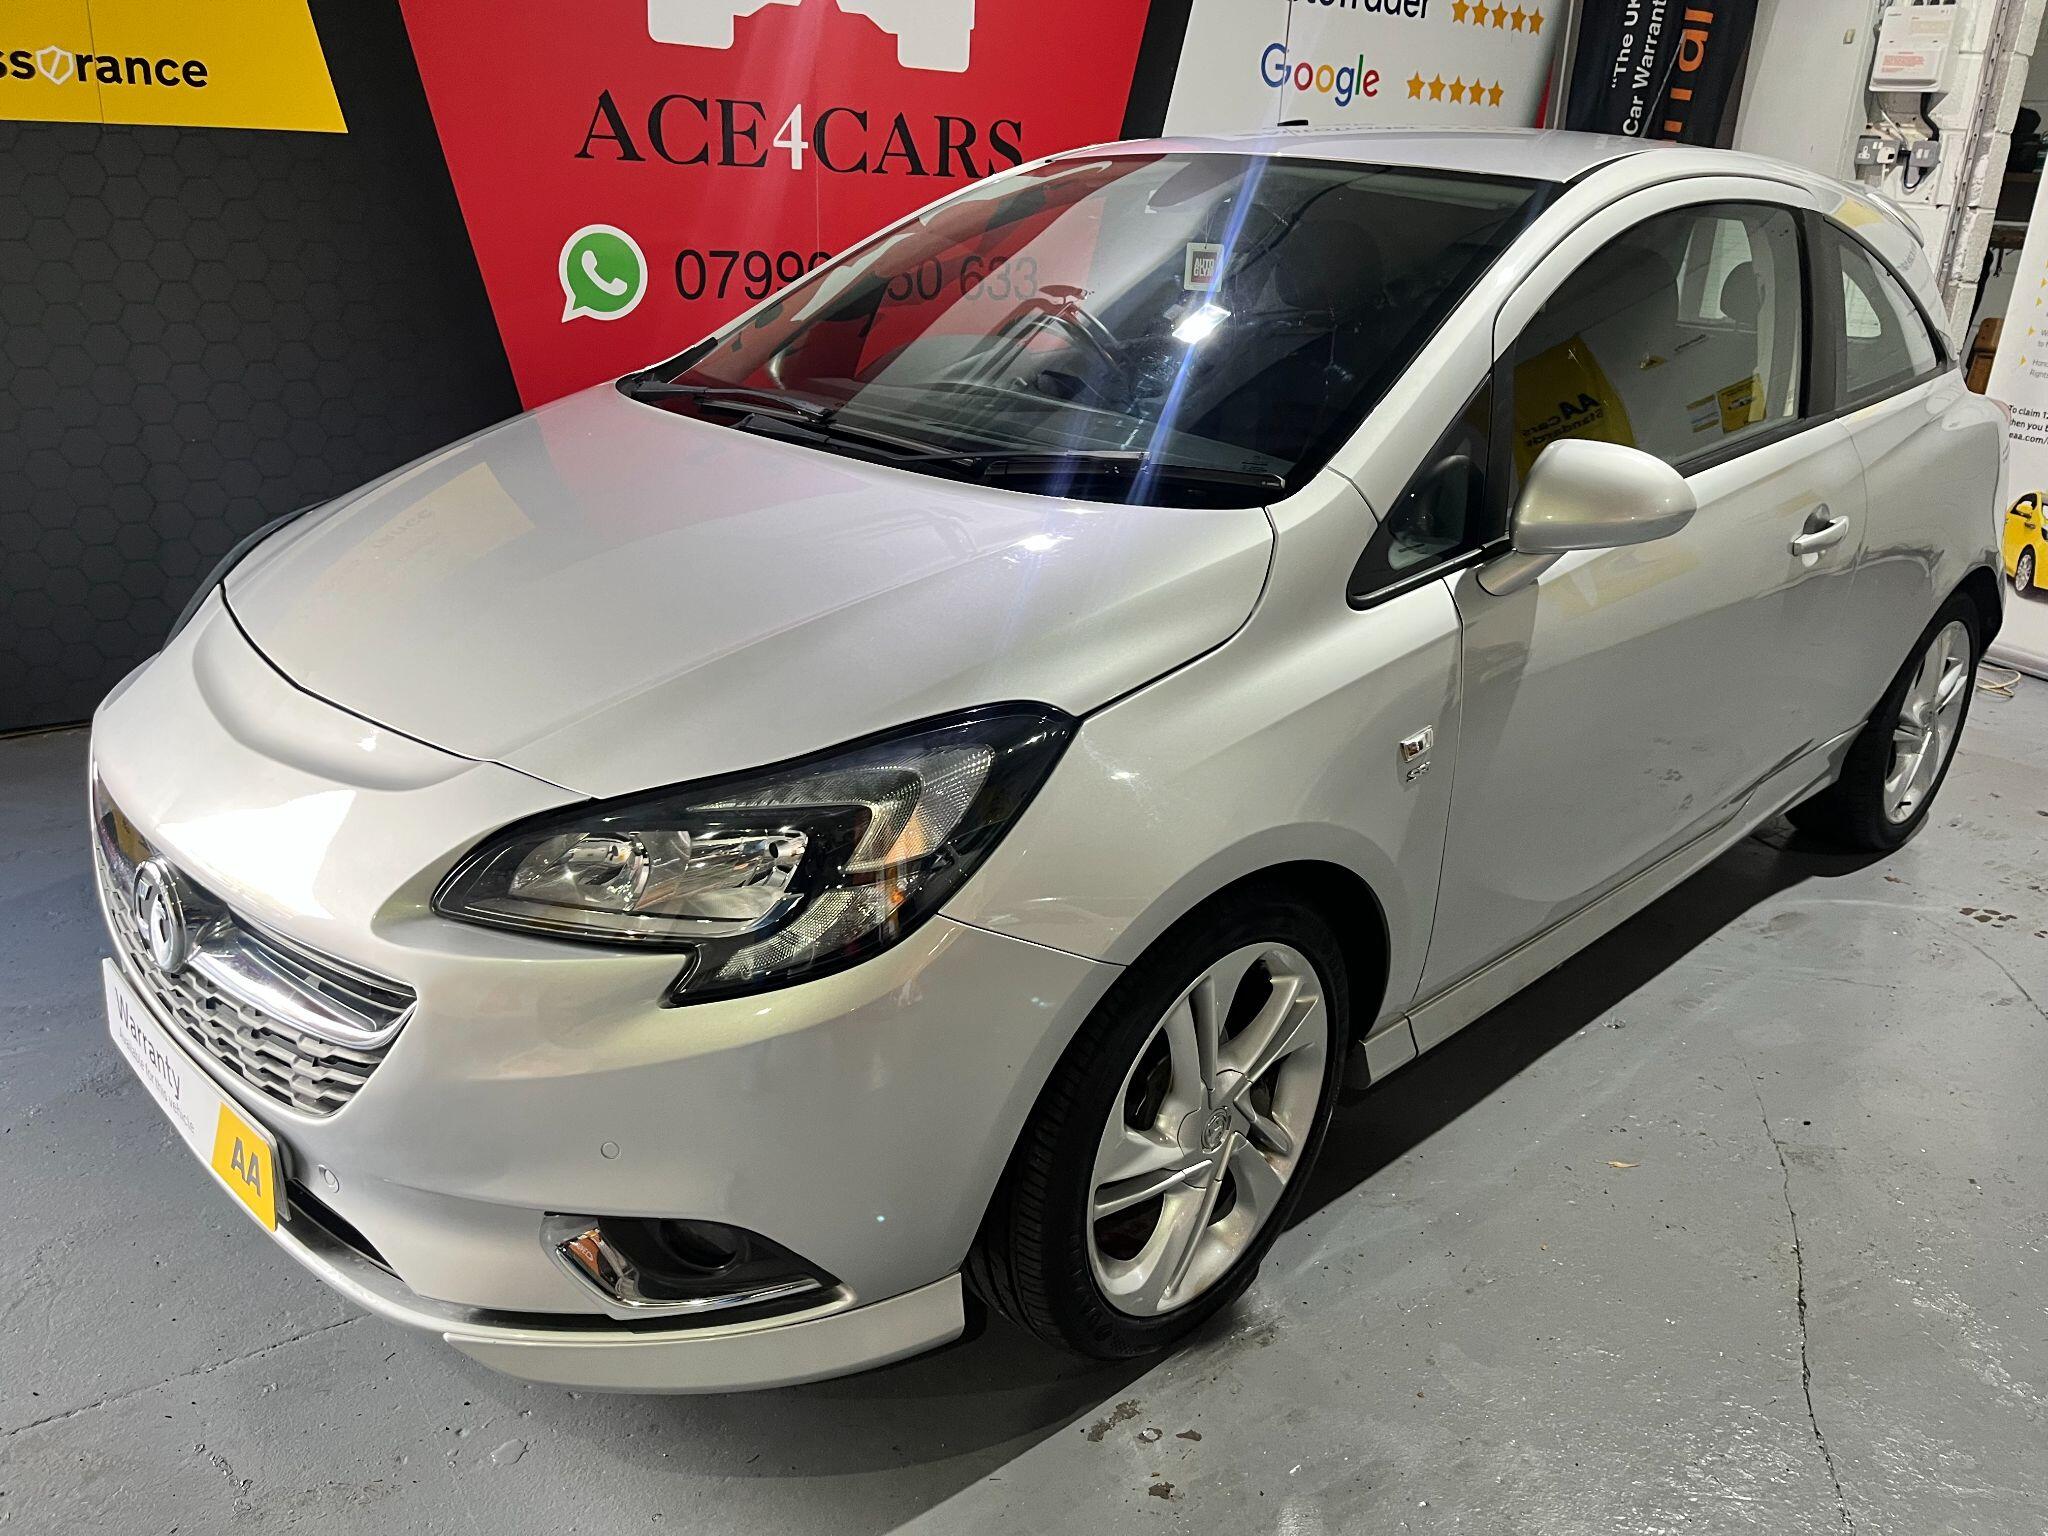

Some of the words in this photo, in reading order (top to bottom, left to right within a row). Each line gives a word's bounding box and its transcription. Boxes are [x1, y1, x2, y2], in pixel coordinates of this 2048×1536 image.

[1261, 43, 1380, 107] Google
[574, 89, 1023, 179] ACE4CARS
[1622, 96, 1644, 135] Car
[960, 255, 1039, 301] 633
[2018, 408, 2041, 418] claim
[2027, 422, 2043, 431] you
[114, 986, 181, 1101] Warranty
[231, 1136, 262, 1197] AA
